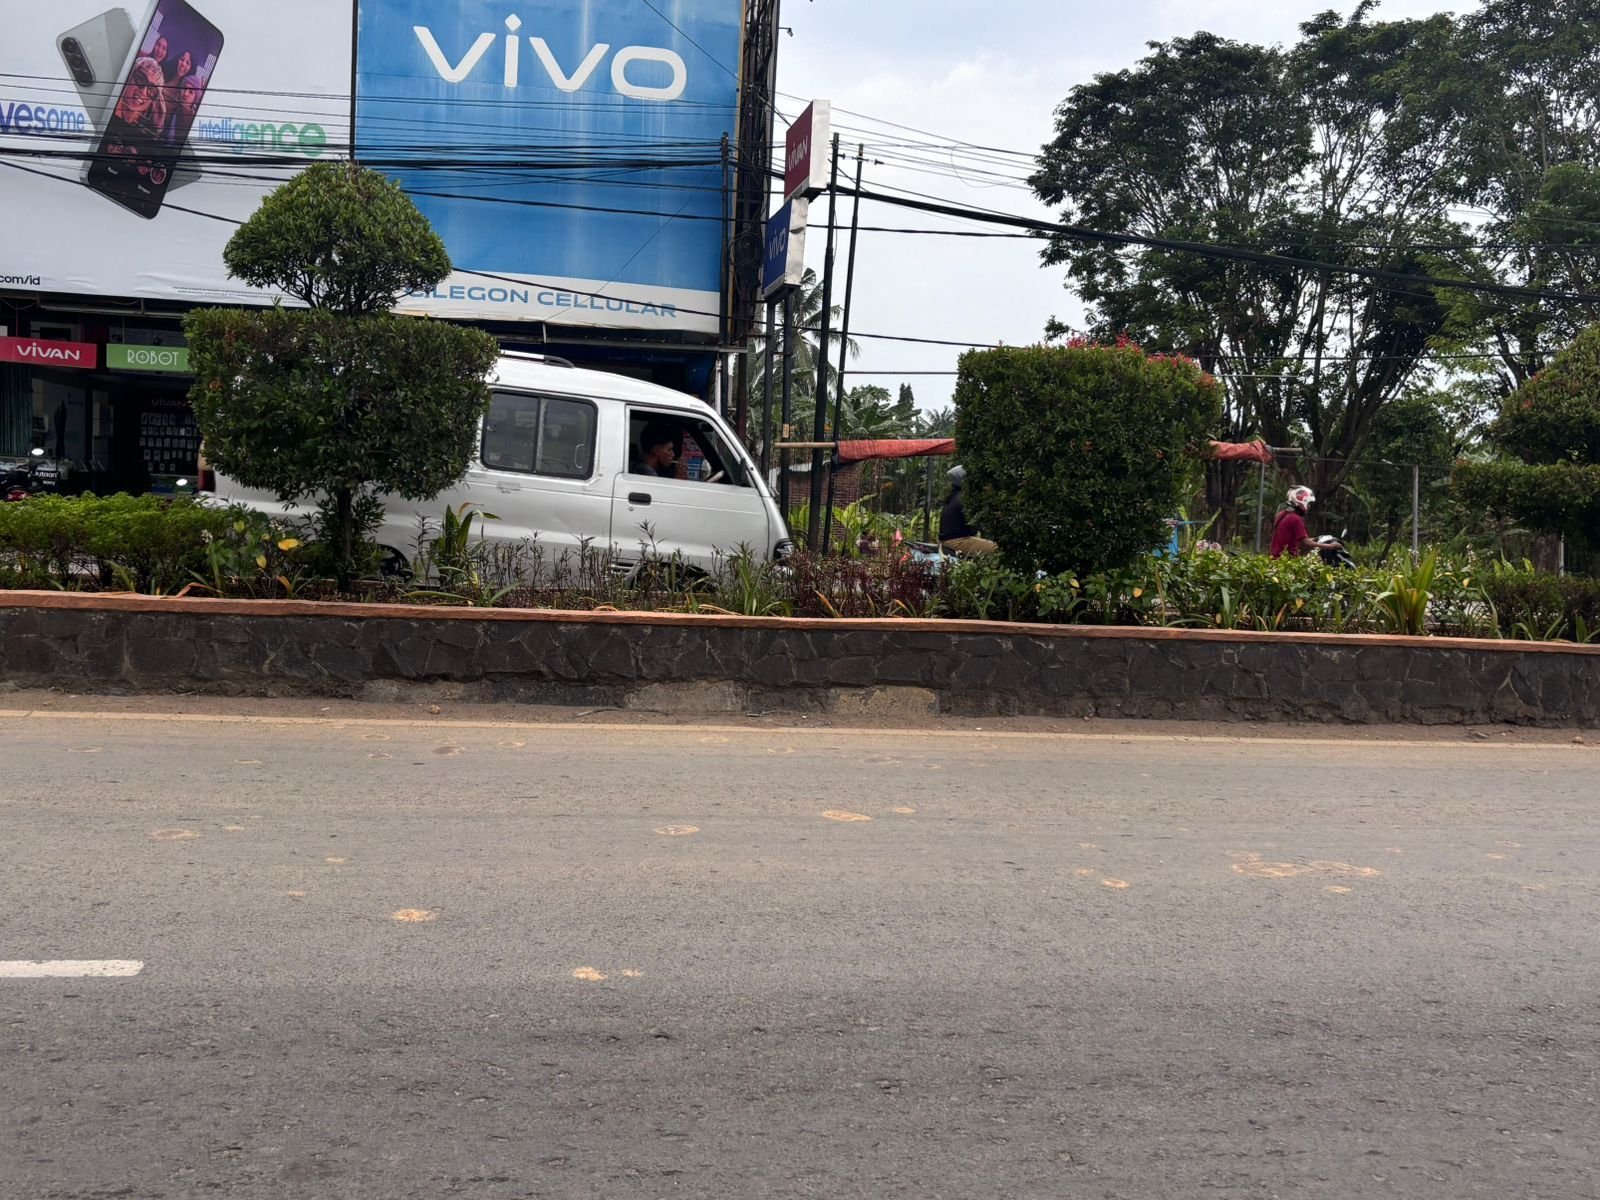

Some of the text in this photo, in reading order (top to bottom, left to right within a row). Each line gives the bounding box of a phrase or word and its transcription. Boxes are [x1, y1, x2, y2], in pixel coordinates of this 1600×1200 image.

[413, 13, 687, 101] vivo
[537, 291, 677, 318] CELLULAR
[127, 349, 179, 366] ROBOT
